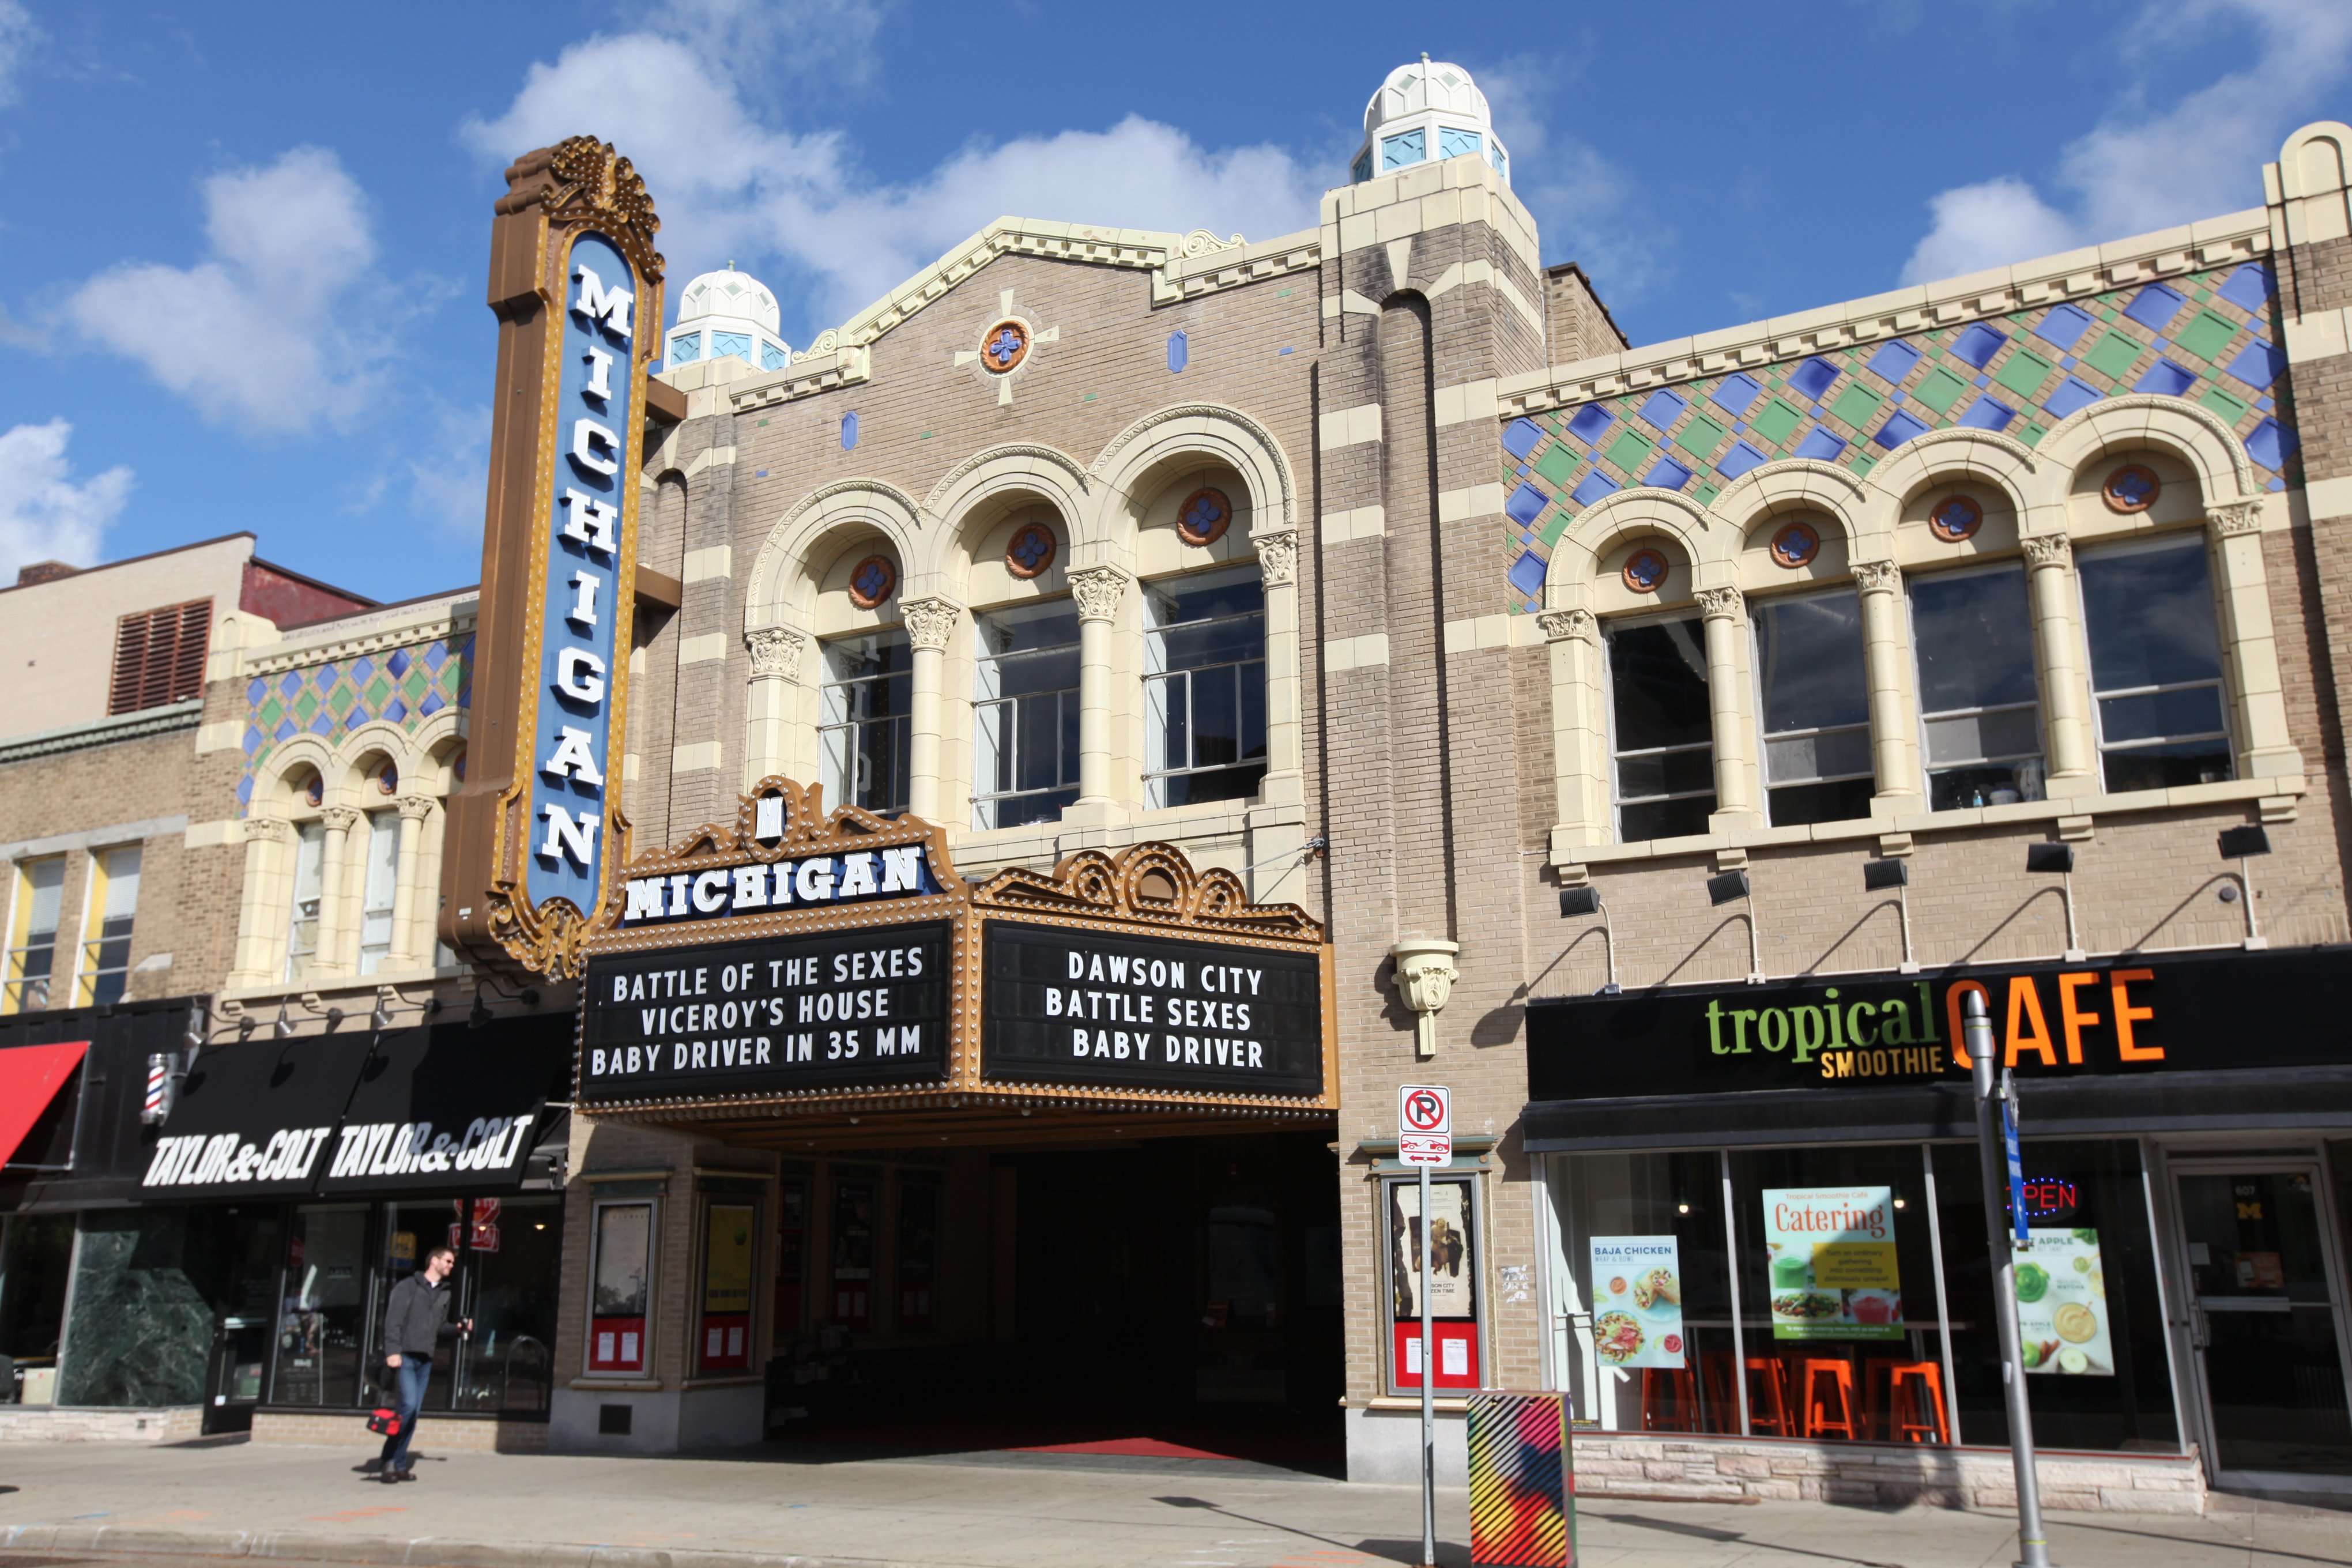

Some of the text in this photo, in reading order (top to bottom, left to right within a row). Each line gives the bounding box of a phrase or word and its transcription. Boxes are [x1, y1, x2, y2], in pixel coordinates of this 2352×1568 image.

[540, 264, 634, 865] MICHIGAN
[755, 796, 783, 839] M
[624, 846, 924, 919] MICHIGAN
[614, 947, 922, 1002] BATTLE OF THE SEXES
[1069, 951, 1262, 995] DAWSON CITY
[642, 989, 888, 1035] VICEROY'S HOUSE
[1047, 987, 1250, 1031] BATTLE SEXES
[1705, 968, 2166, 1071] tropical CAFE
[592, 1025, 920, 1075] BABY DRIVER IN 35 MM
[1073, 1028, 1263, 1068] BABY DRIVER
[1820, 1046, 1944, 1079] SMOOTHIE
[2235, 1185, 2255, 1196] 607
[2236, 1203, 2263, 1219] M
[1776, 1203, 1886, 1238] Catering
[2038, 1237, 2074, 1245] APPLE
